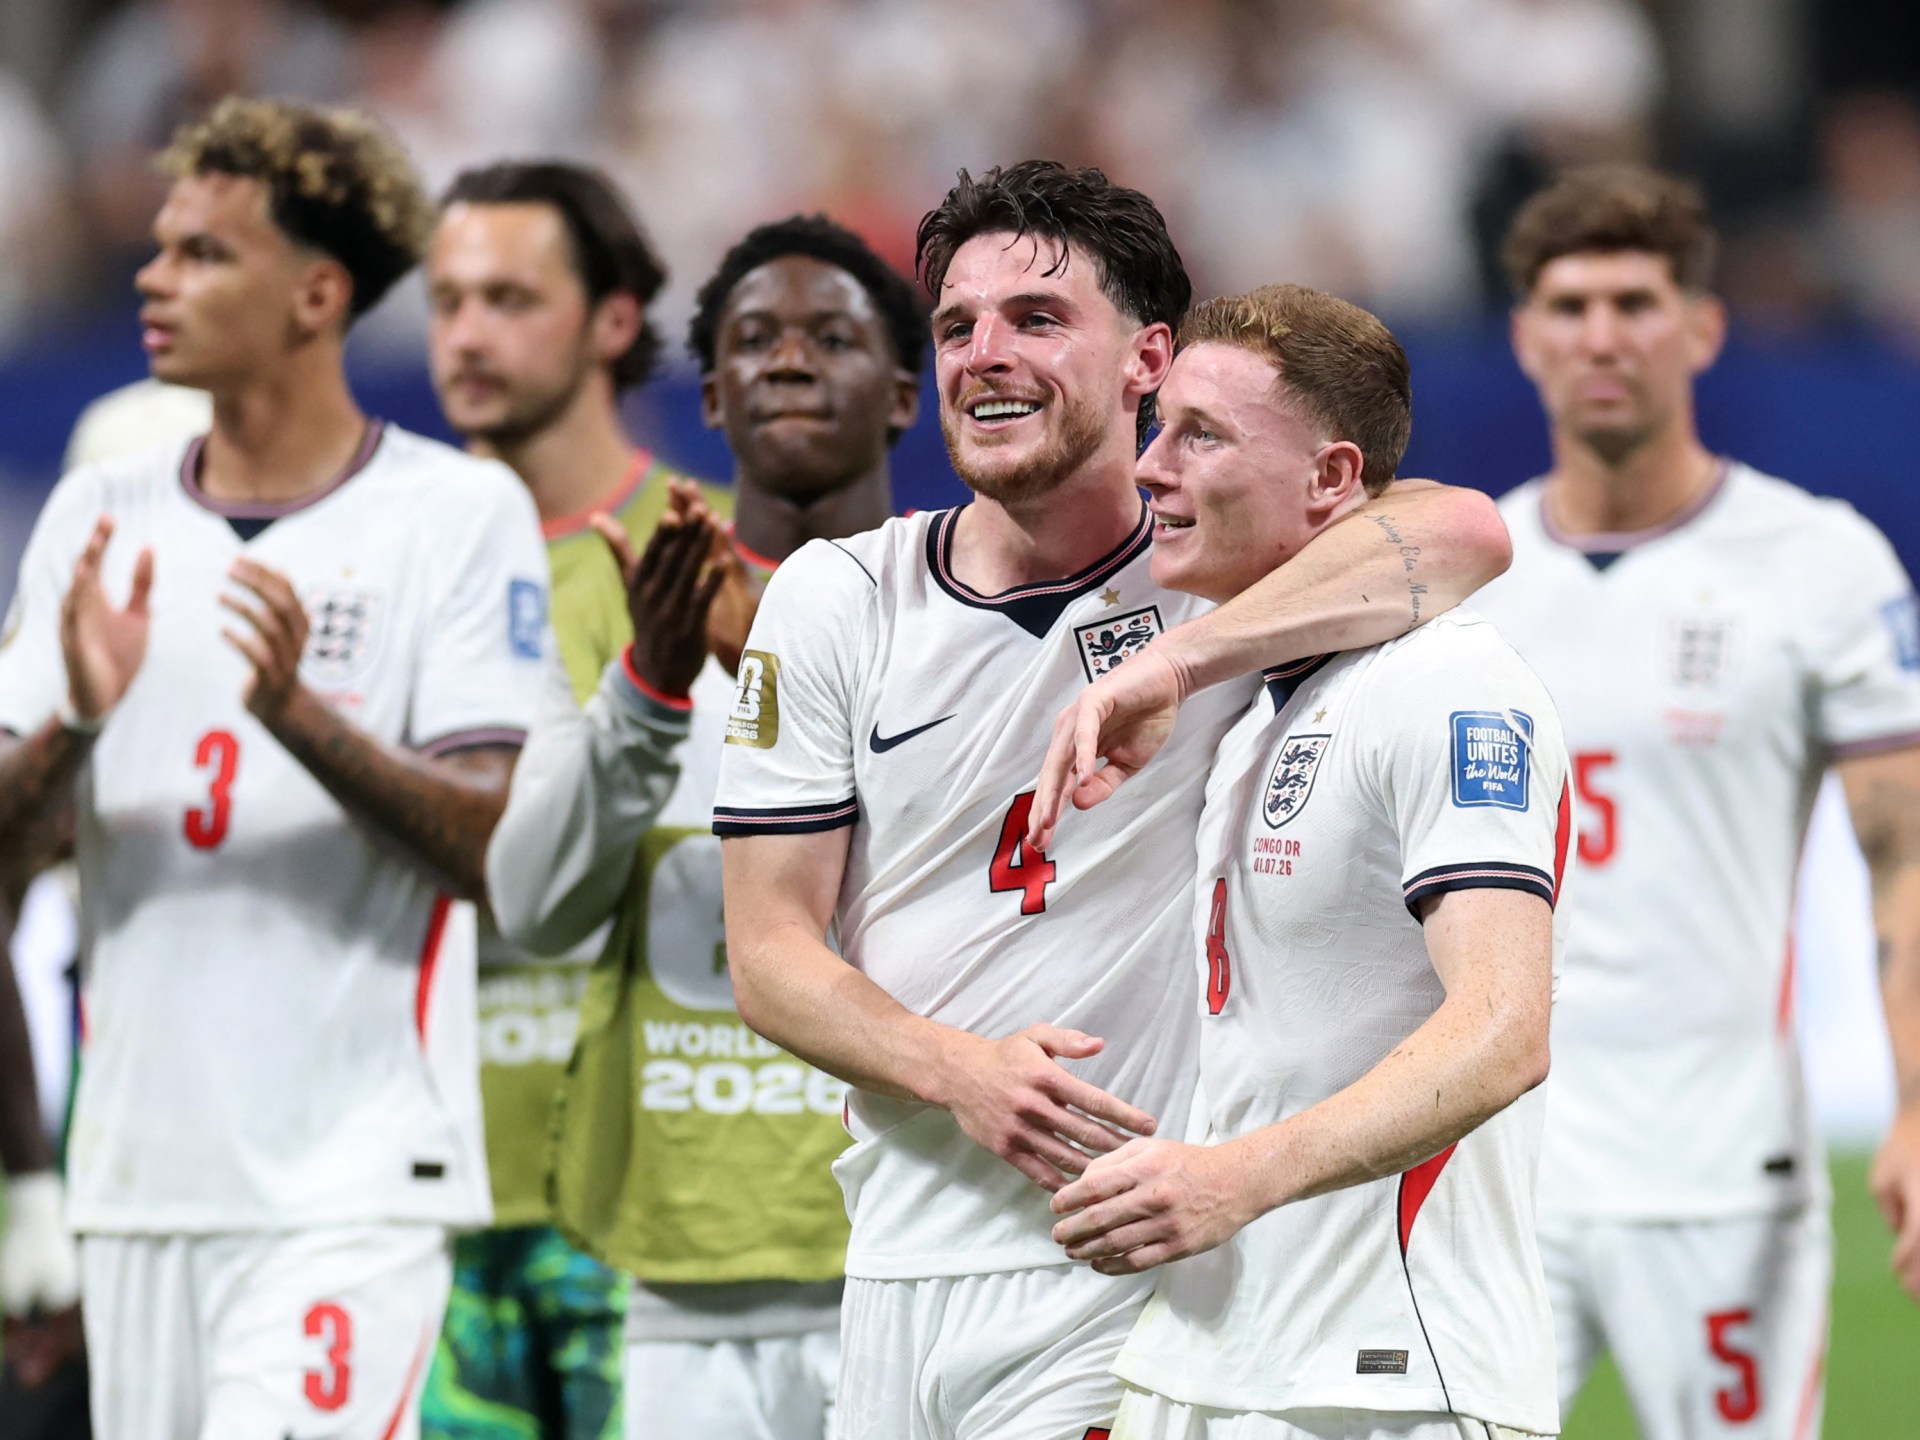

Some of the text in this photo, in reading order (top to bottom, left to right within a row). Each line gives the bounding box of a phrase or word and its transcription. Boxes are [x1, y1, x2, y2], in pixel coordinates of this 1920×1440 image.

[737, 706, 751, 714] FIFA
[1466, 727, 1519, 746] FOOTBALL
[1467, 742, 1519, 766] UNITES
[184, 730, 238, 850] 3
[1464, 762, 1520, 785] the World
[1482, 781, 1505, 792] FIFA
[1574, 751, 1617, 868] 5
[988, 790, 1056, 916] 4
[1254, 837, 1300, 857] CONGO DR
[1254, 857, 1292, 876] 01.07.26
[1206, 877, 1231, 1015] 8
[641, 1058, 844, 1115] 2026
[304, 1302, 351, 1413] 3
[1706, 1310, 1758, 1424] 5
